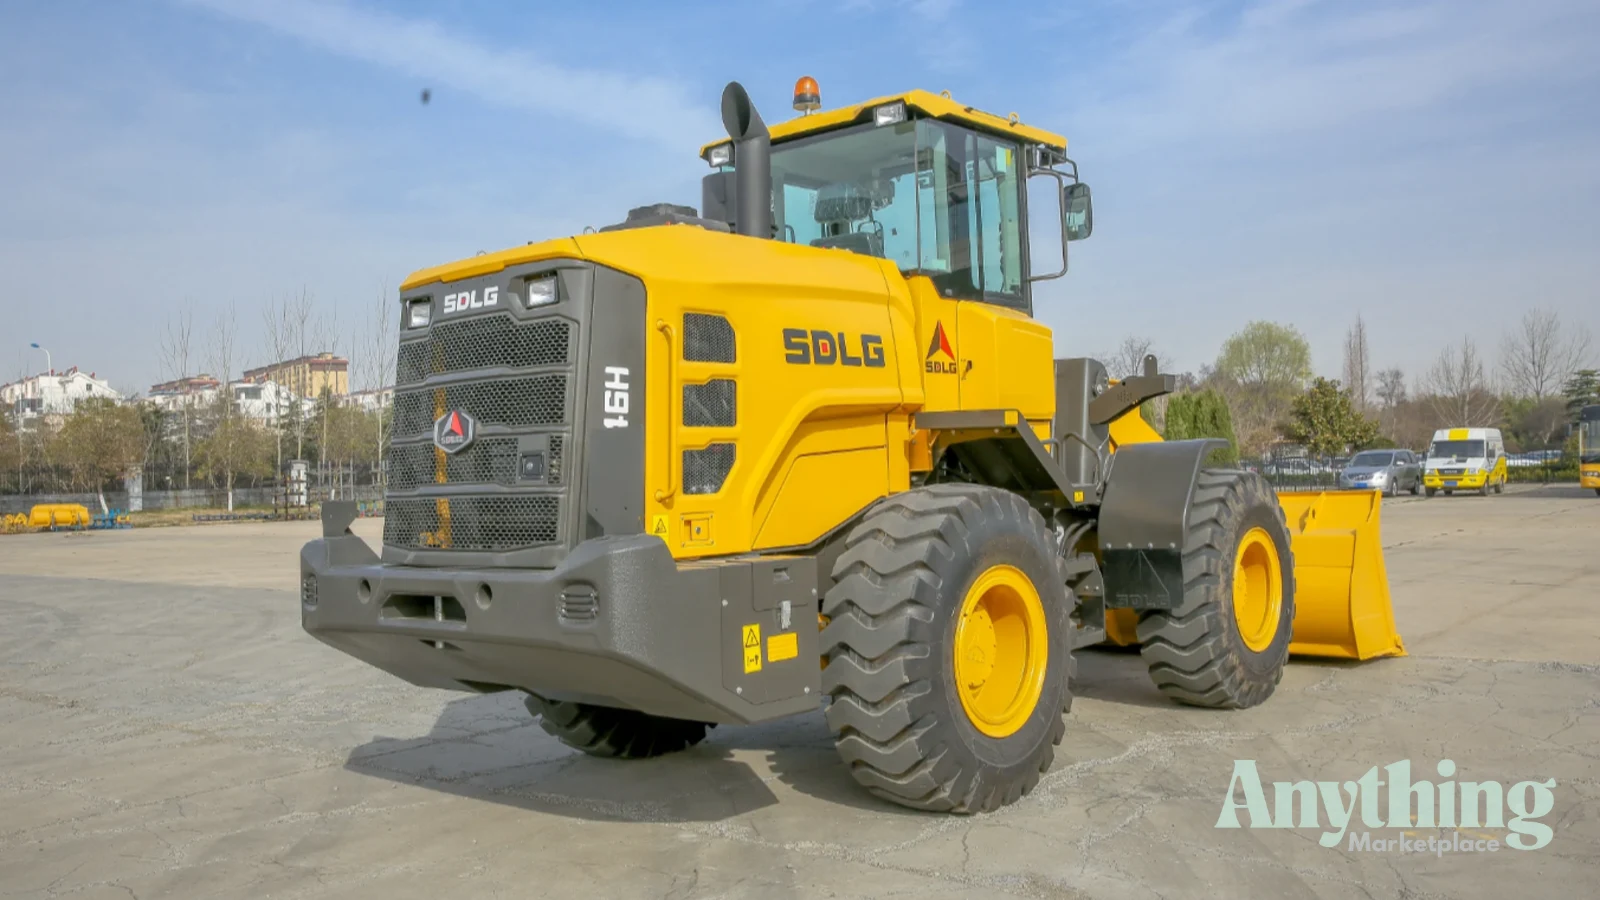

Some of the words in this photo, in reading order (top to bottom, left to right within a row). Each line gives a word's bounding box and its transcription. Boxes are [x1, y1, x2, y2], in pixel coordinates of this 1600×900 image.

[443, 286, 499, 314] SDLG
[783, 328, 886, 367] SDLG
[925, 360, 957, 374] SDLG
